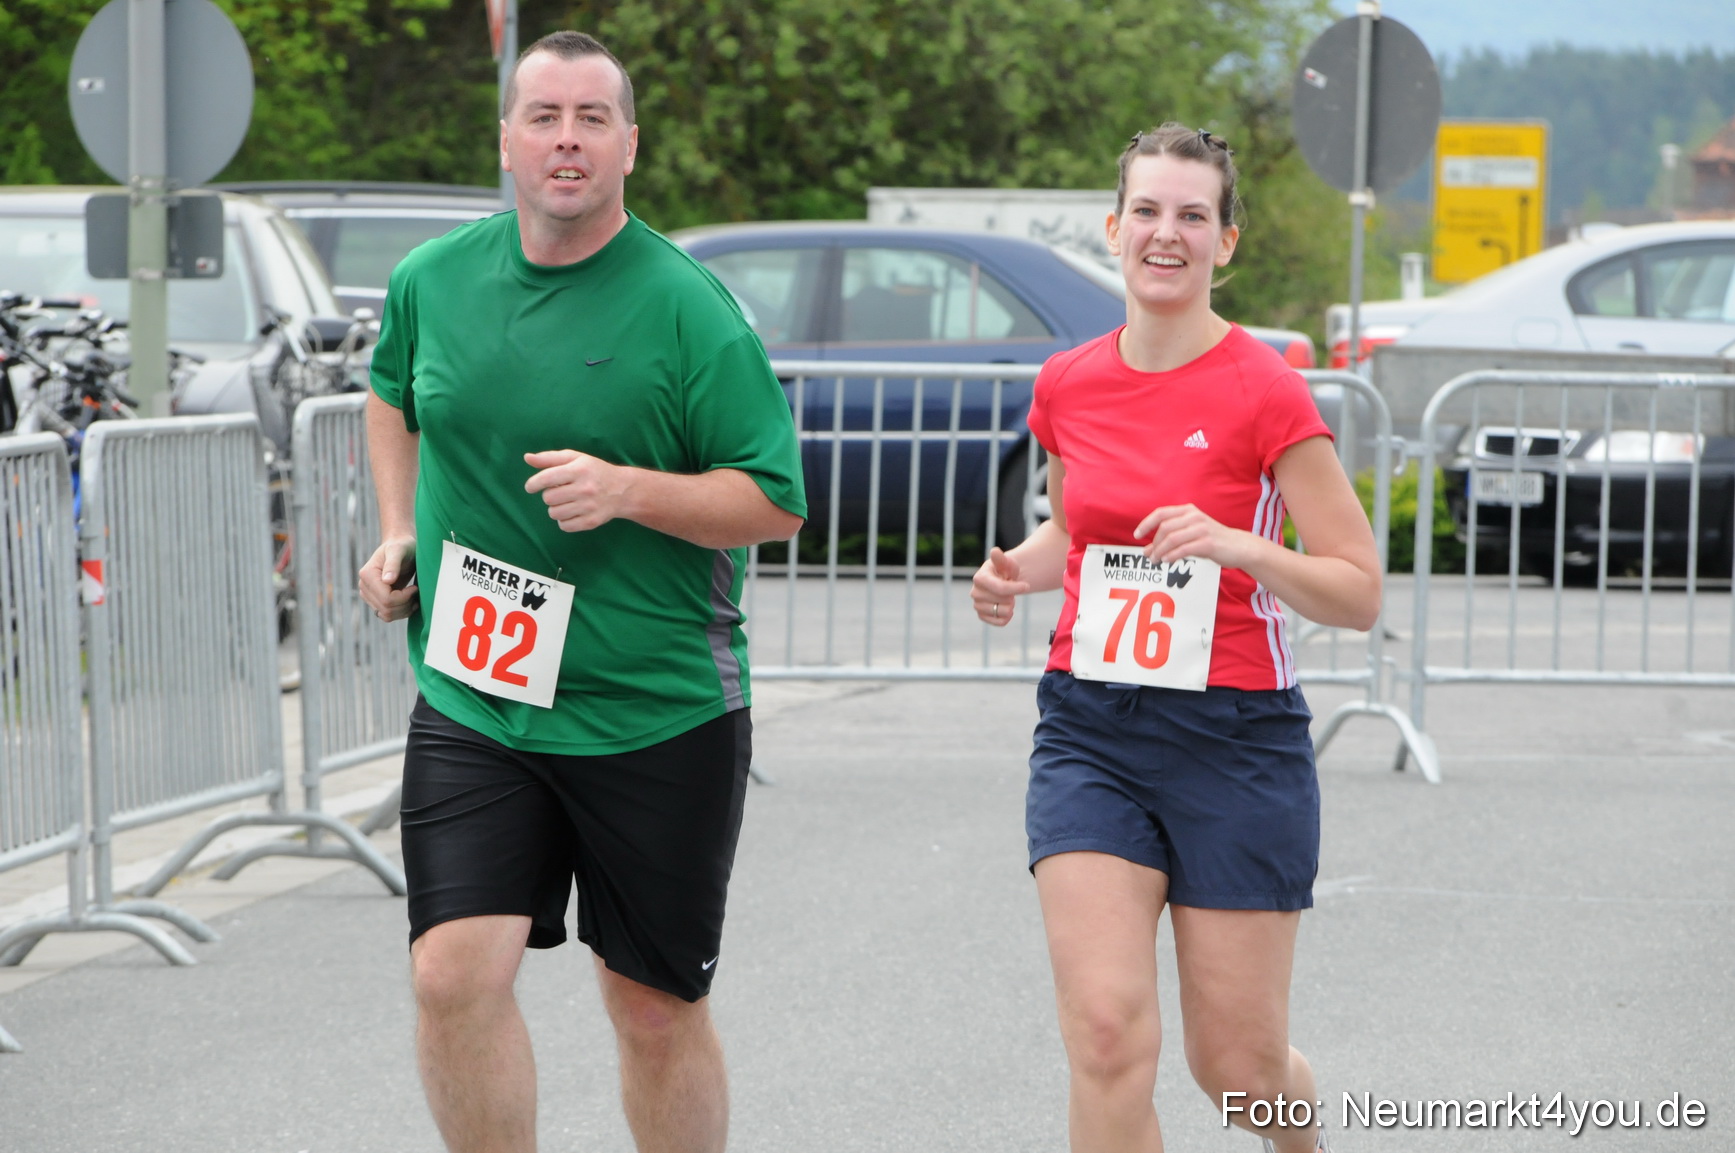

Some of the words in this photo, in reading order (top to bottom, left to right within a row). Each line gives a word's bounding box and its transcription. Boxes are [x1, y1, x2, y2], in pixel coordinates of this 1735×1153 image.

[1184, 439, 1209, 450] adidas
[461, 569, 518, 601] WERBUNG
[462, 554, 521, 590] MEYER
[1103, 569, 1163, 583] WERBUNG
[456, 595, 538, 688] 82
[1103, 588, 1175, 670] 76
